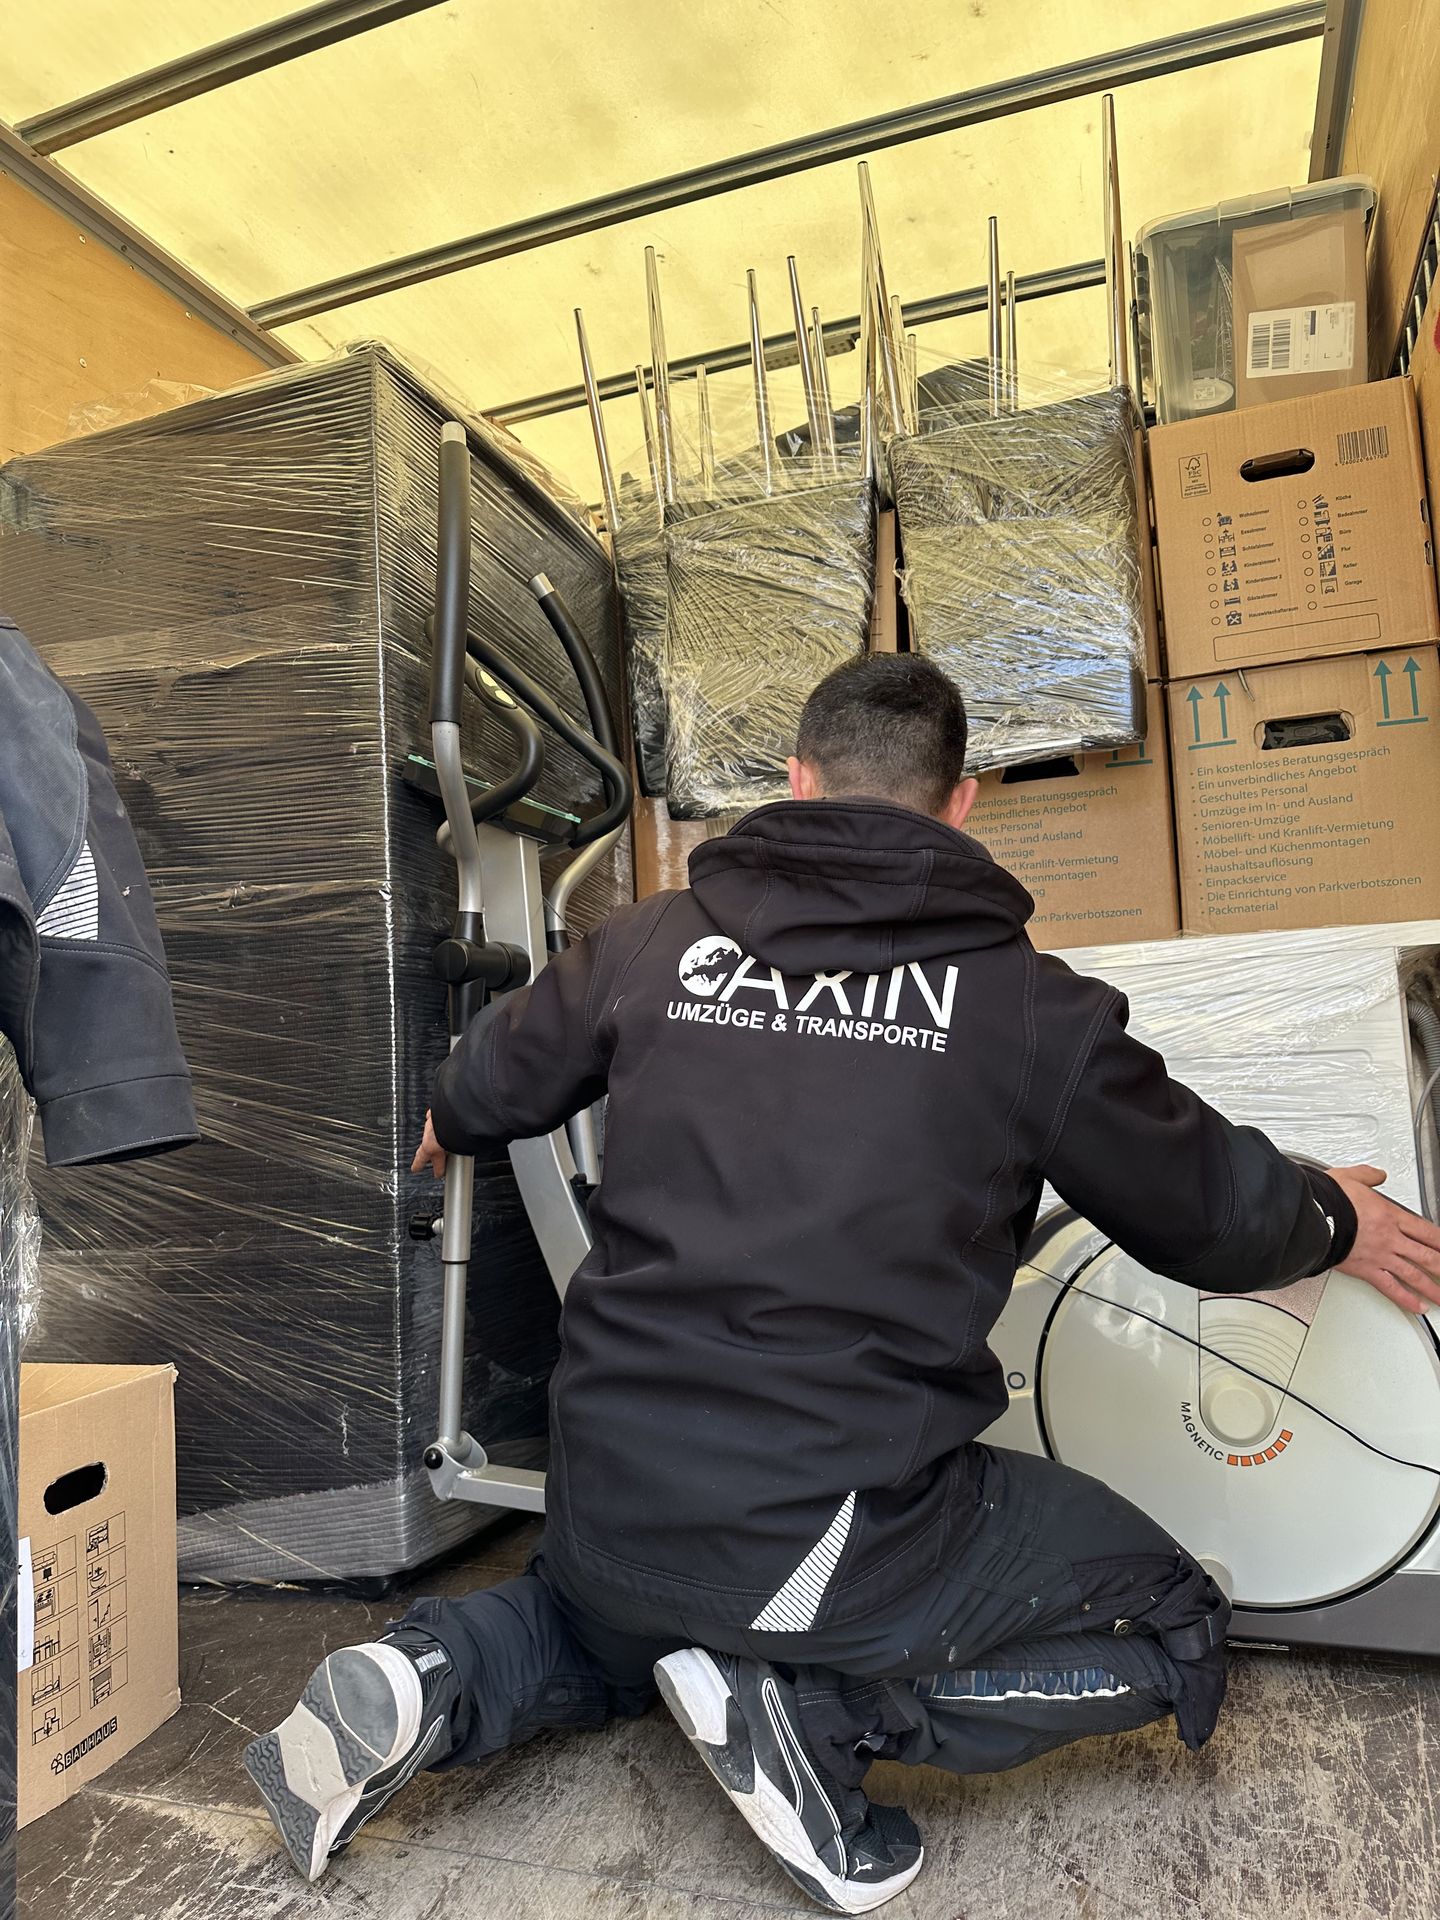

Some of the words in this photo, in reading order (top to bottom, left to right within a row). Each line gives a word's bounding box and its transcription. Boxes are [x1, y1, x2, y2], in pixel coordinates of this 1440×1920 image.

[1197, 766, 1213, 776] Ein
[1217, 759, 1280, 774] kostenloses
[1283, 746, 1391, 768] Beratungsgespräch
[1198, 780, 1214, 790] Ein
[1218, 769, 1305, 788] unverbindliches
[1308, 765, 1356, 780] Angebot
[973, 797, 1018, 808] stenloses
[1020, 786, 1118, 803] Beratungsgespräch
[1199, 790, 1258, 804] Geschultes
[1261, 784, 1308, 795] Personal
[1043, 803, 1087, 817] Angebot
[1201, 805, 1246, 820] Umzüge
[1249, 802, 1262, 813] im
[1265, 802, 1280, 811] In-
[1284, 799, 1305, 809] und
[1308, 793, 1353, 806] Ausland
[965, 823, 998, 835] chultes
[1001, 821, 1043, 832] Personal
[1202, 813, 1300, 832] Senioren-Umzüge
[1203, 832, 1255, 846] Möbellift-
[1258, 828, 1280, 839] und
[1283, 819, 1394, 837] Kranlift-Vermietung
[990, 838, 1002, 846] im
[1004, 837, 1017, 845] In-
[1020, 835, 1040, 844] und
[1043, 830, 1083, 841] Ausland
[1204, 847, 1242, 860] Möbel-
[1245, 844, 1267, 855] und
[1270, 836, 1370, 853] Küchenmontagen
[1005, 863, 1017, 872] nd
[1019, 855, 1119, 871] Kranlift-Vermietung
[1205, 855, 1313, 873] Haushaltsauflösung
[1019, 870, 1097, 884] chenmontagen
[1206, 872, 1287, 888] Einpackservice
[1208, 892, 1225, 902] Die
[1228, 885, 1291, 900] Einrichtung
[1295, 884, 1316, 894] von
[1319, 875, 1421, 892] Parkverbotszonen
[1050, 908, 1142, 922] Parkverbotszonen
[1209, 901, 1278, 915] Packmaterial
[718, 955, 959, 1029] AXIN
[667, 1001, 766, 1030] UMZÜGE
[771, 1014, 787, 1032] &
[796, 1014, 948, 1053] TRANSPORTE
[1180, 1401, 1225, 1461] MAGNETIC
[65, 1716, 117, 1769] BAUHAUS
